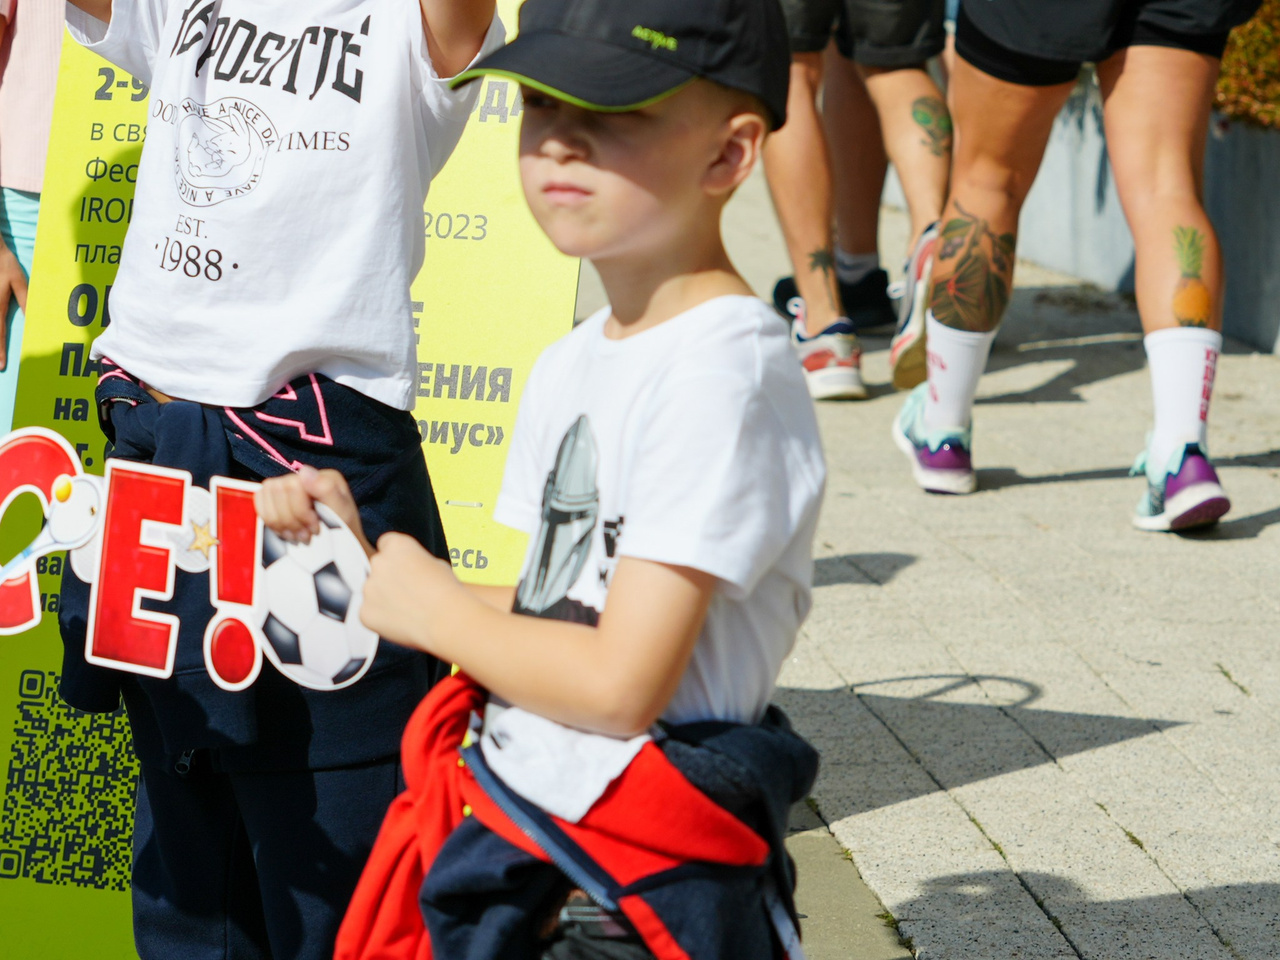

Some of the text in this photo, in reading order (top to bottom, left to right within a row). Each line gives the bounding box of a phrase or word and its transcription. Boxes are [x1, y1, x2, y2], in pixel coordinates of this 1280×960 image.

[85, 157, 139, 183] Фес
[79, 197, 488, 241] IRO 2023
[175, 214, 208, 239] EST.
[74, 244, 122, 265] пла
[416, 362, 513, 403] ЕНИЯ
[53, 397, 505, 455] на риус»
[36, 547, 489, 576] ва есь
